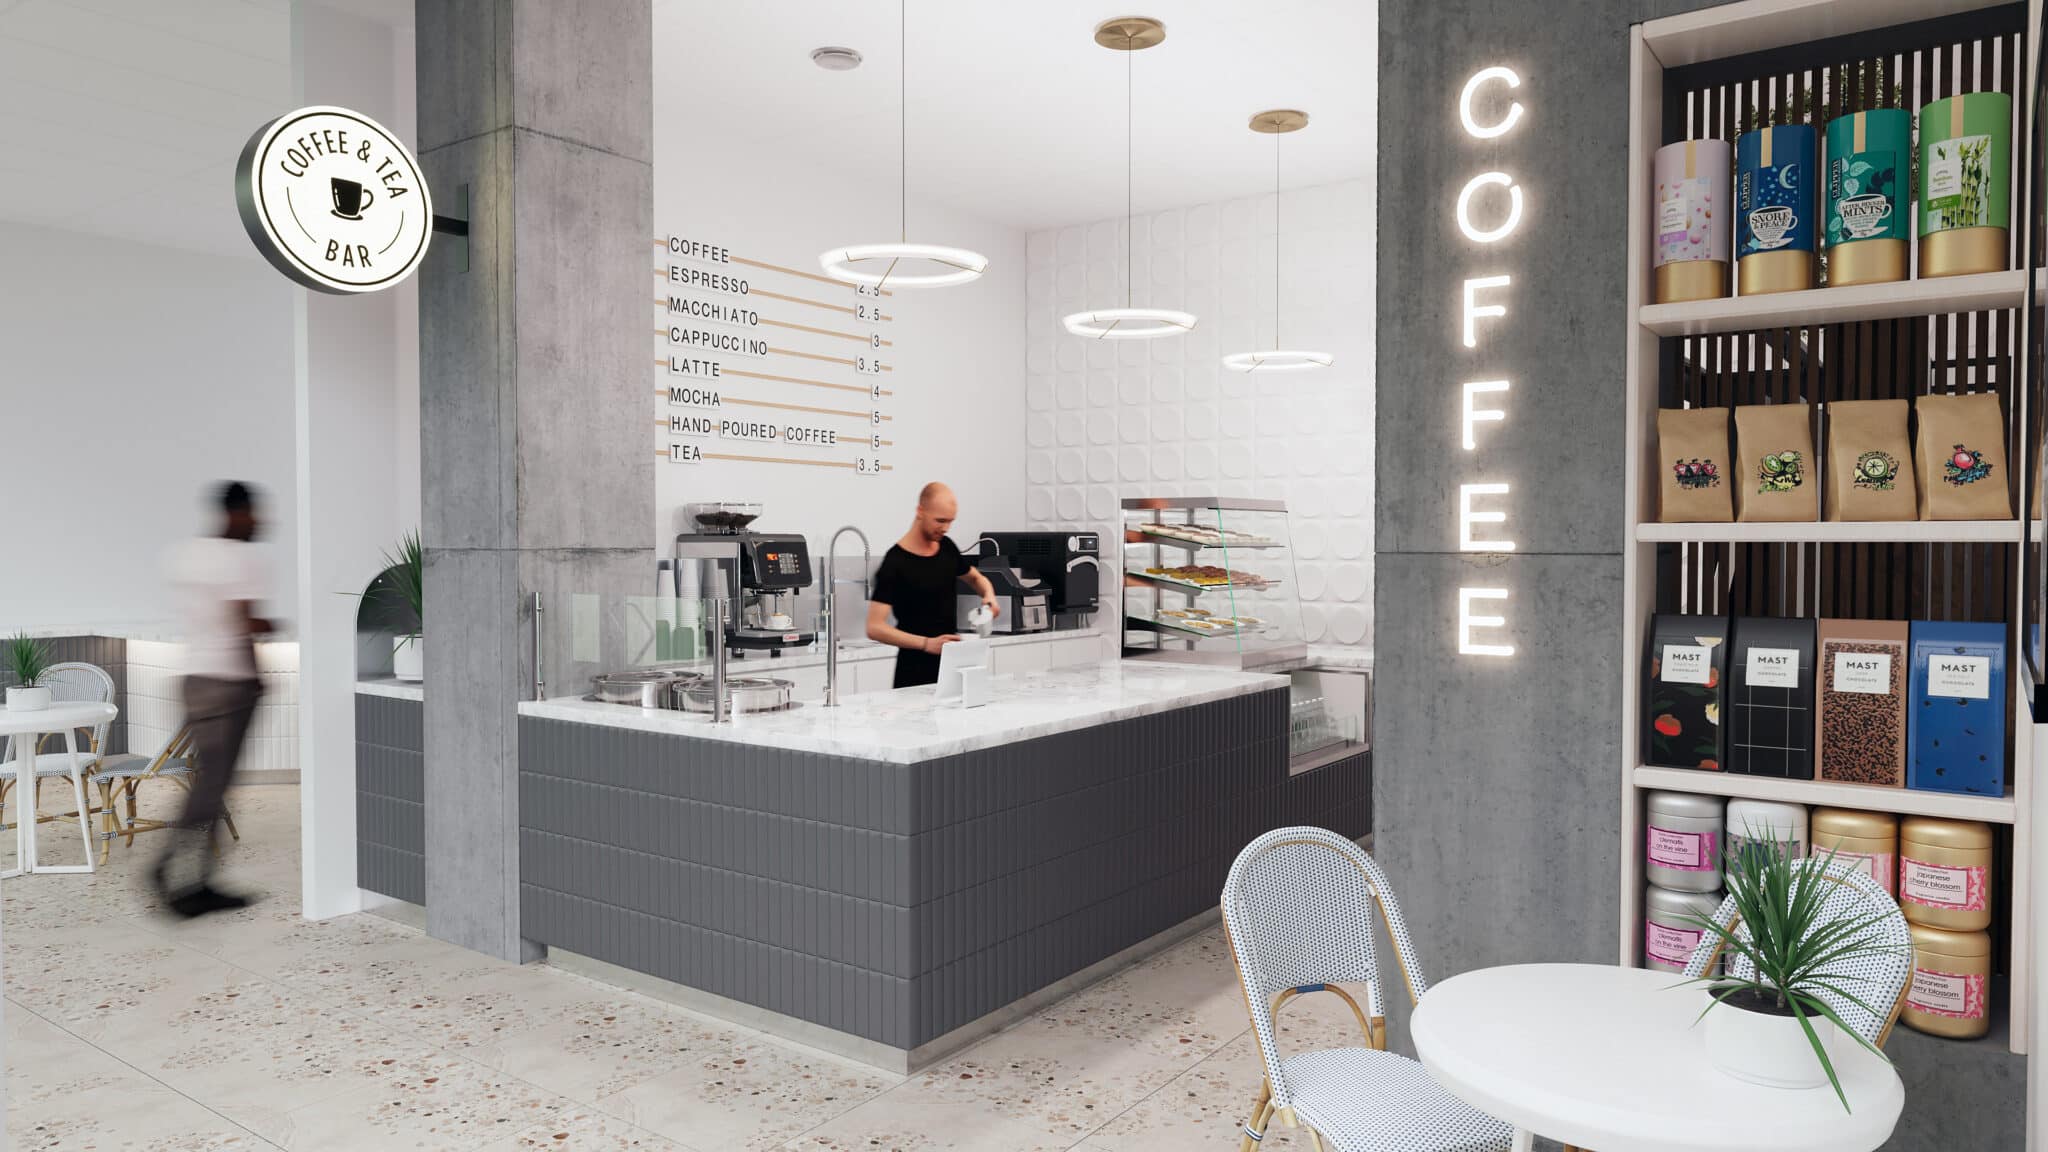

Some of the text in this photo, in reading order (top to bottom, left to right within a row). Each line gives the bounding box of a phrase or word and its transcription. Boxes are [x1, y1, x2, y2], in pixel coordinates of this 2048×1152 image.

[281, 130, 408, 199] COFFEE & TEA
[1751, 211, 1790, 224] SNORE
[1760, 220, 1787, 229] PEACE
[1843, 205, 1883, 217] MINTS
[325, 239, 372, 268] BAR
[670, 237, 729, 264] COFFEE
[671, 266, 880, 321] ESPRESSO 2.5
[670, 297, 880, 347] MACCHIATO 3
[671, 327, 880, 373] CAPPUCCINO 3.5
[1457, 67, 1523, 656] COFFEE
[672, 357, 880, 398] LATTE 4
[670, 387, 880, 423] MOCHA 5
[671, 416, 880, 448] HAND POURED COFFEE 5
[672, 445, 880, 472] TEA 3.5
[1672, 653, 1701, 661] MAST
[1758, 656, 1788, 664] MAST
[1846, 661, 1879, 669] MAST
[1941, 664, 1976, 672] MAST
[1930, 881, 1961, 890] blossom
[1928, 988, 1959, 998] blossom
